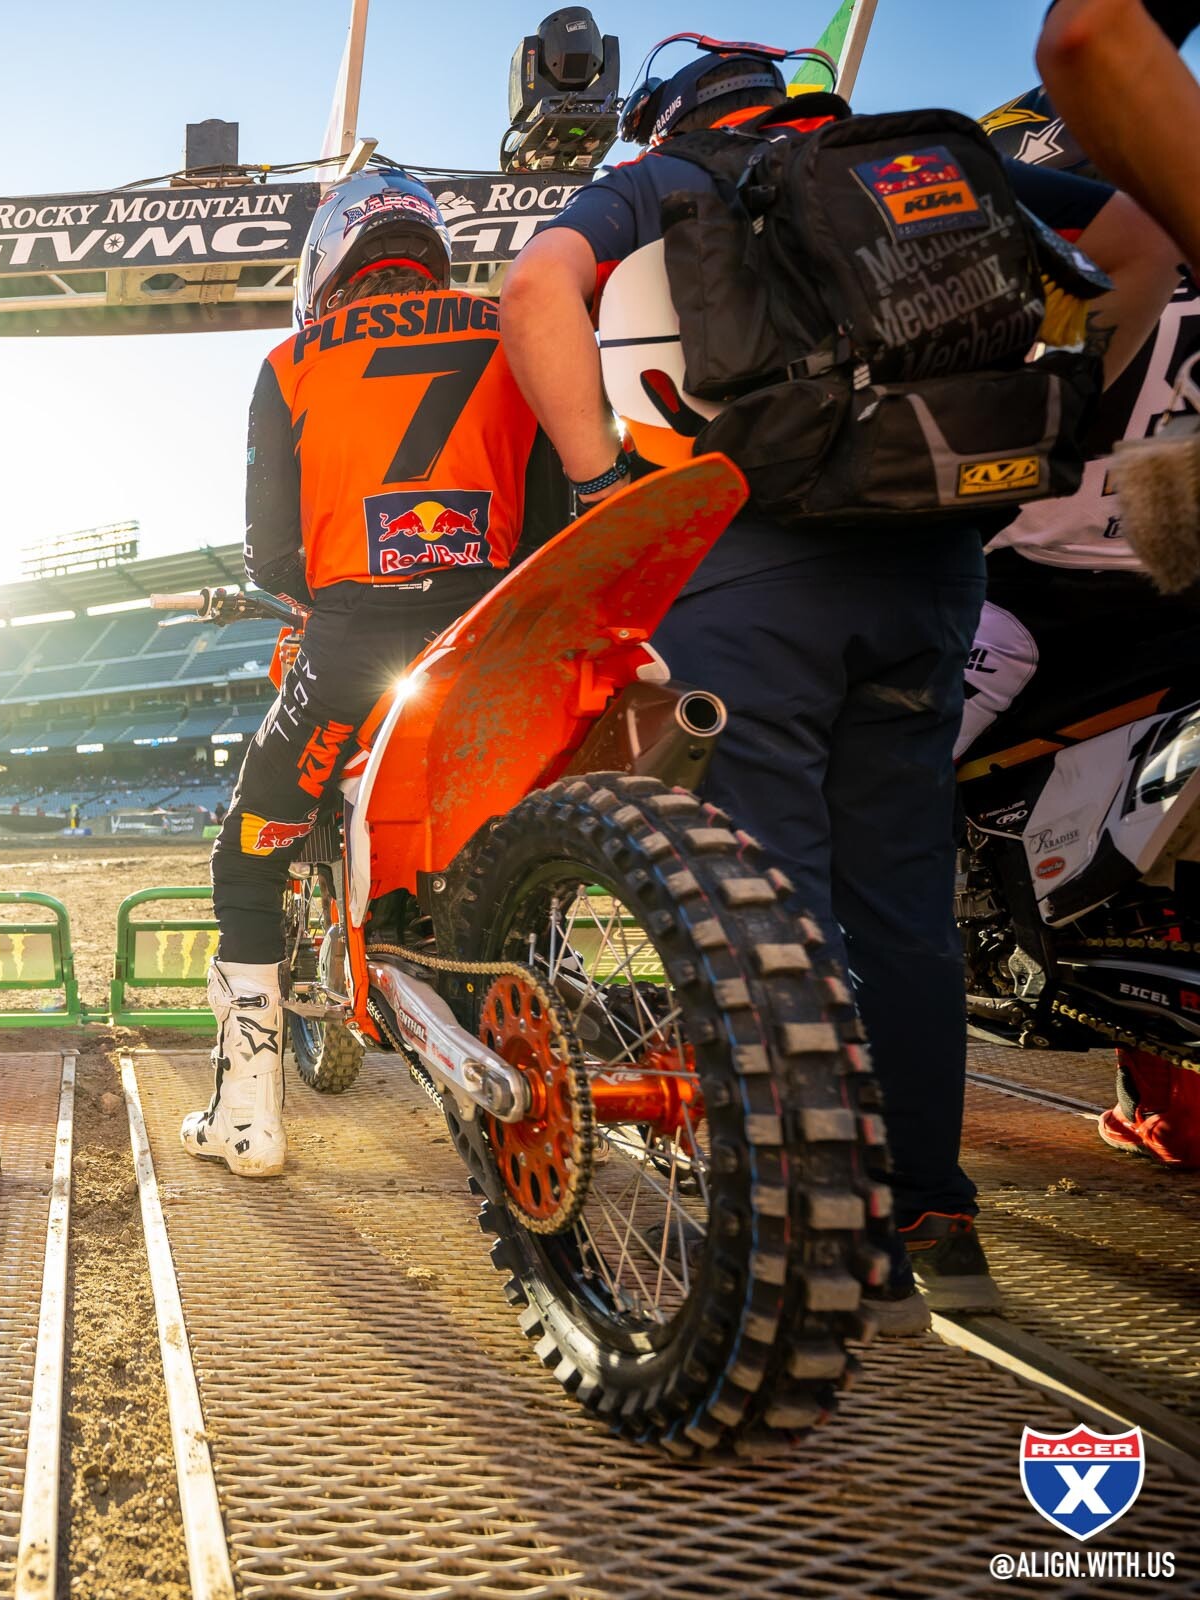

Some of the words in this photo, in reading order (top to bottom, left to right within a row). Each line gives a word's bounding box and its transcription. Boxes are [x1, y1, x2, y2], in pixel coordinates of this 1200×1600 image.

[655, 96, 682, 132] RACING
[102, 194, 292, 224] MOUNTAIN
[482, 183, 588, 212] ROCK
[903, 190, 964, 216] KTM
[293, 297, 502, 361] PLESSING
[362, 337, 501, 486] 7
[380, 543, 437, 575] Red
[434, 541, 484, 566] Bull
[296, 719, 355, 799] KTM
[1119, 982, 1171, 1006] EXCEL
